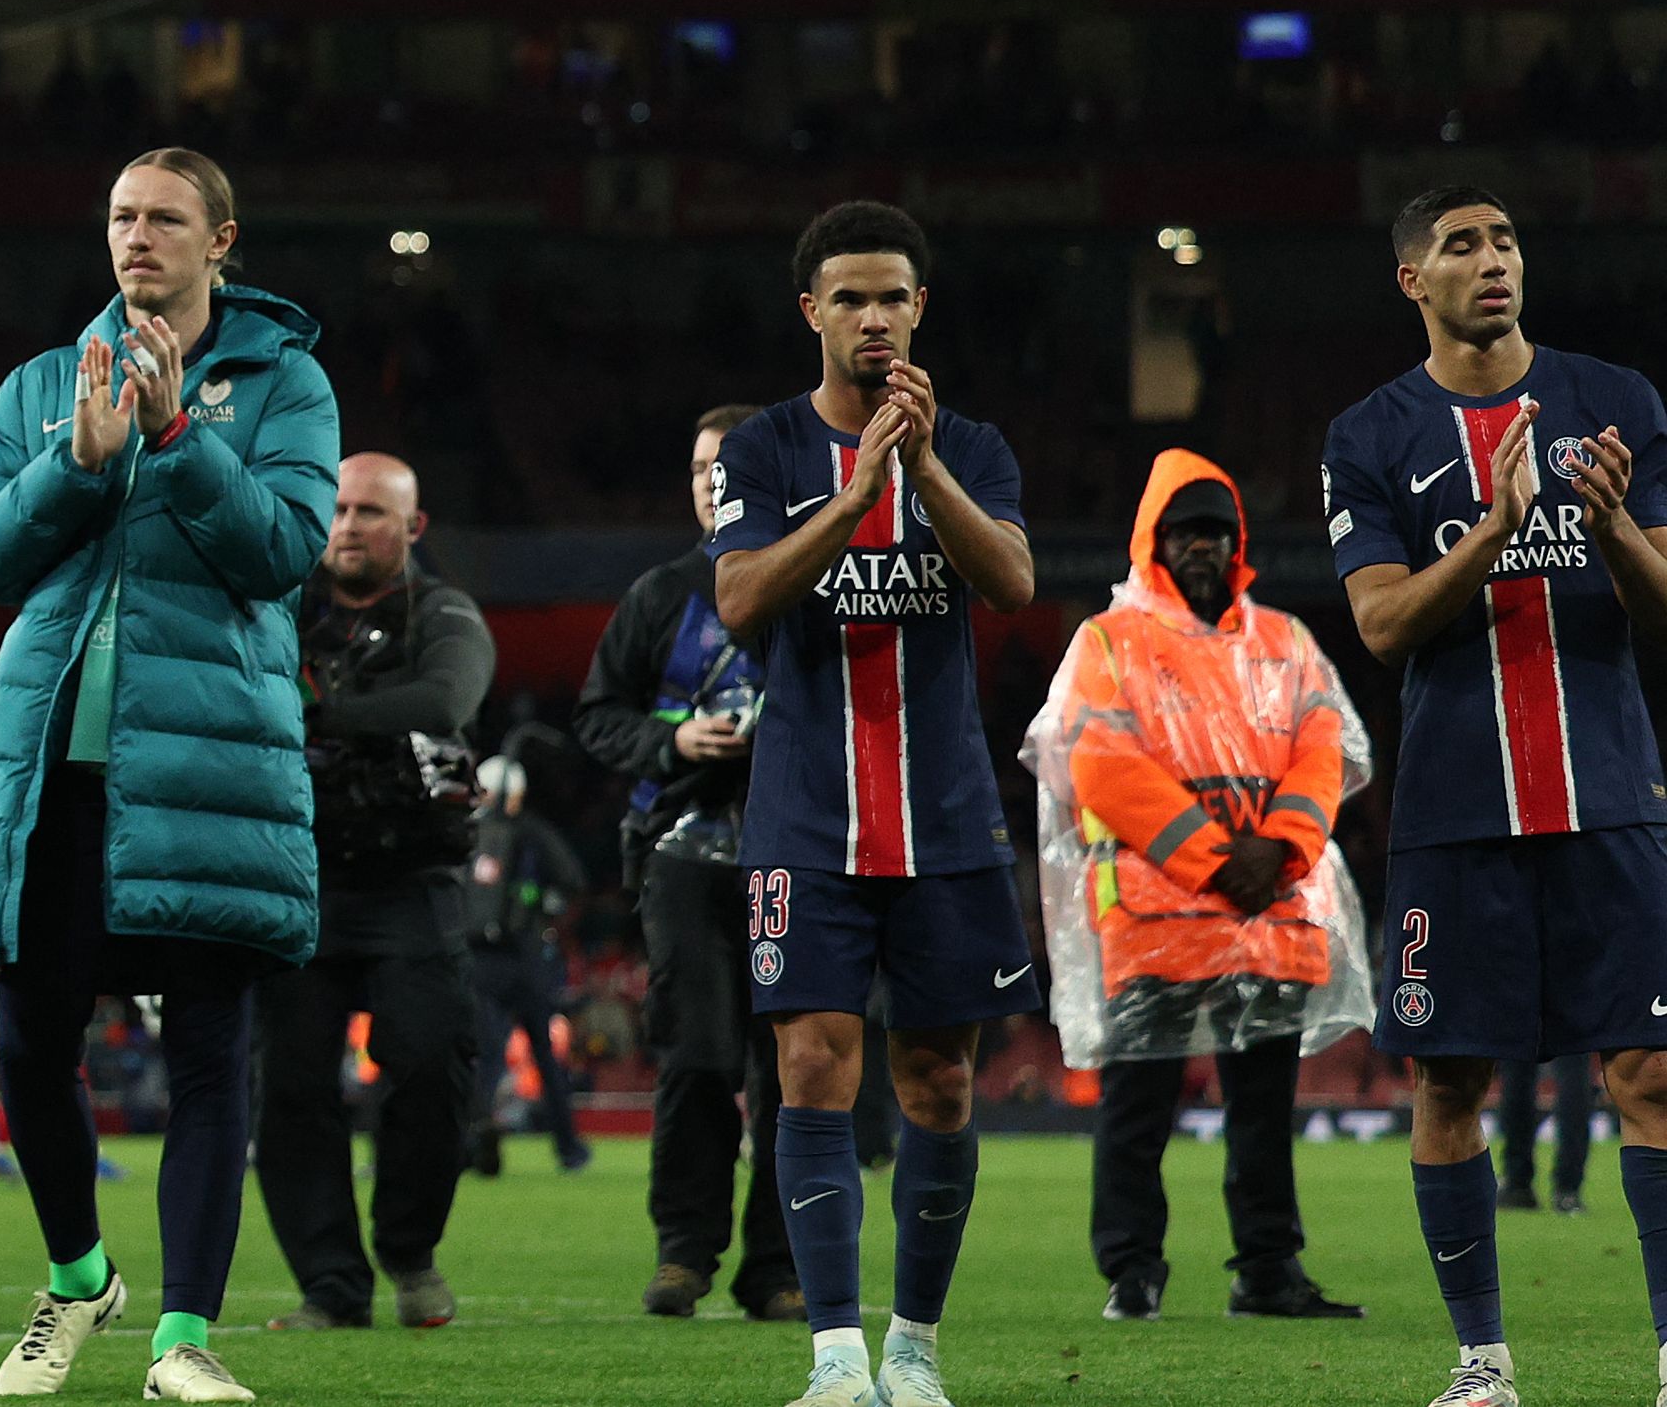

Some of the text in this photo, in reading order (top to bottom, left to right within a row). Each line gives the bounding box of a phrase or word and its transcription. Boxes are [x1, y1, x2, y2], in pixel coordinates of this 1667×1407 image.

[188, 405, 234, 420] QATAR
[834, 593, 949, 615] AIRWAYS
[748, 868, 791, 940] 33
[1402, 908, 1429, 979] 2
